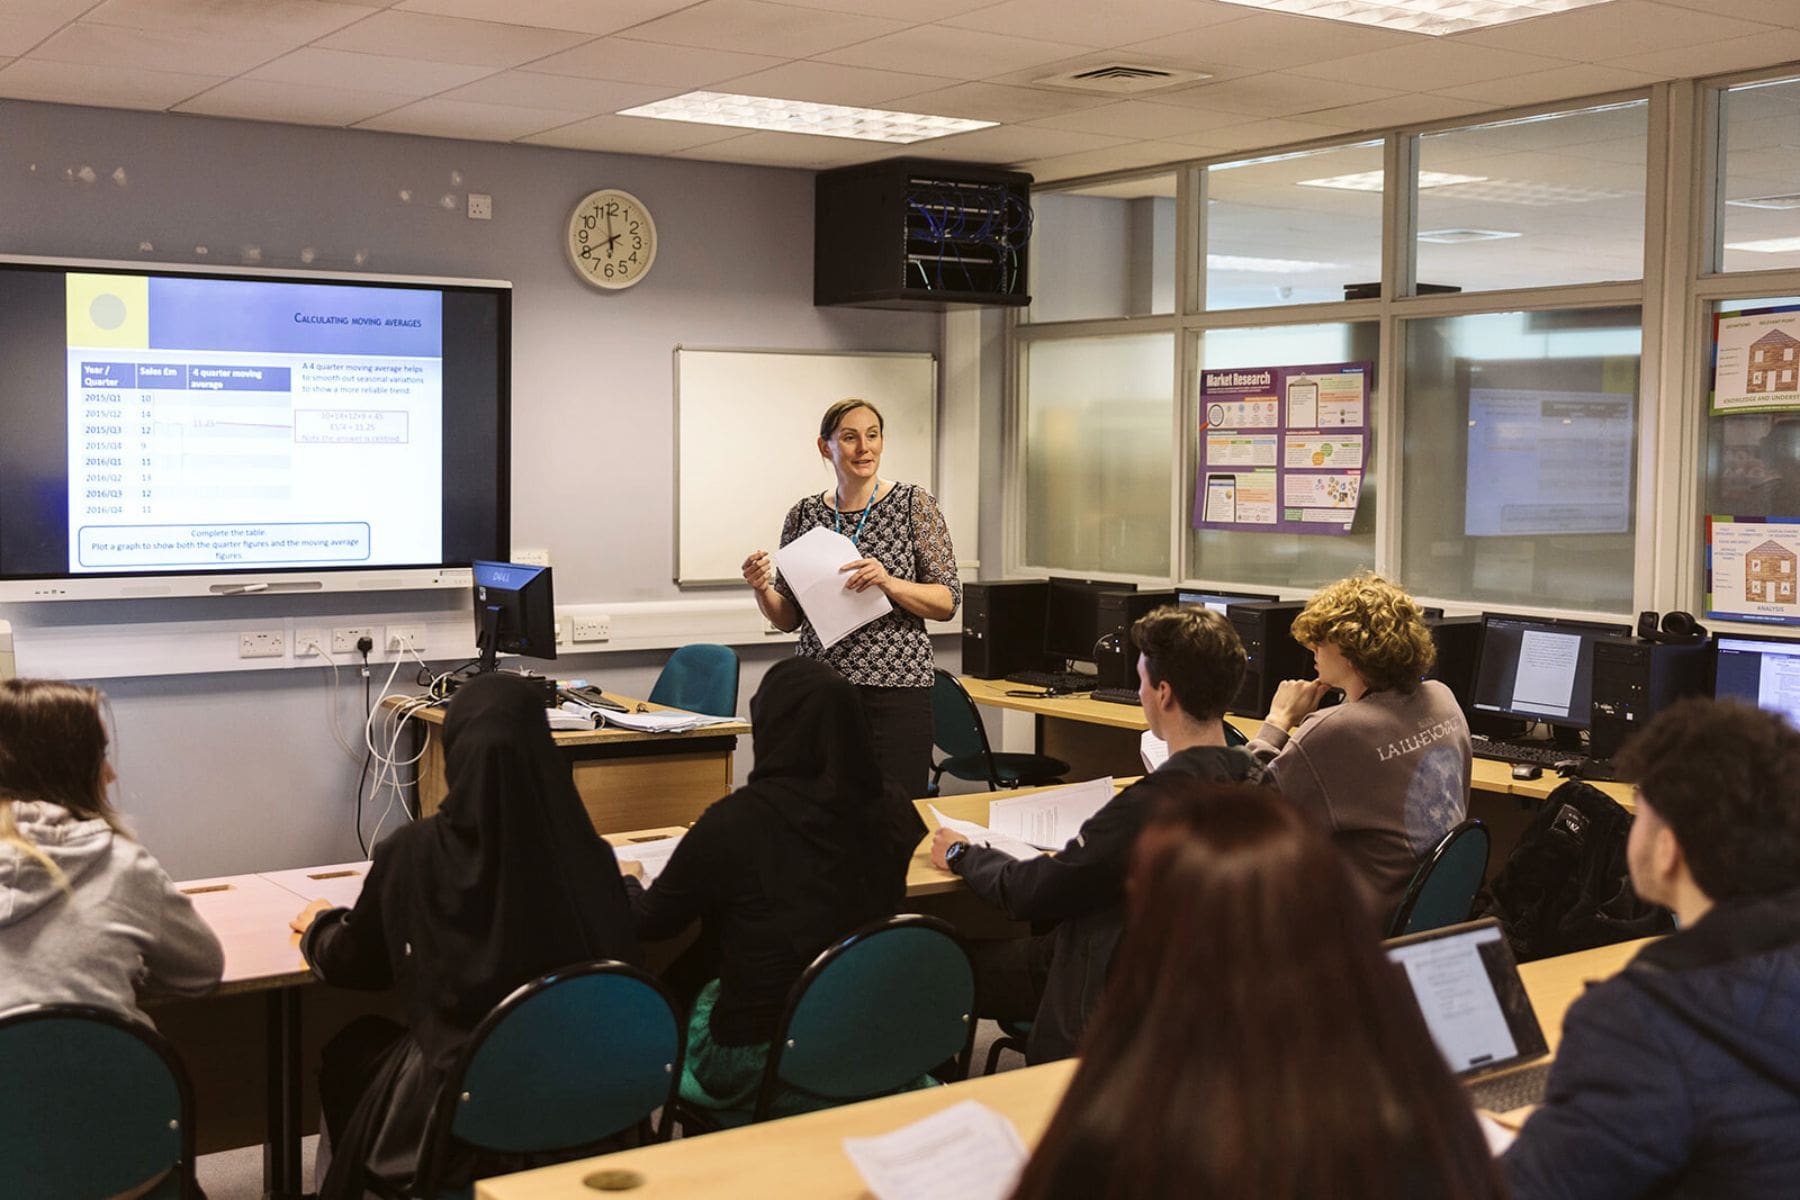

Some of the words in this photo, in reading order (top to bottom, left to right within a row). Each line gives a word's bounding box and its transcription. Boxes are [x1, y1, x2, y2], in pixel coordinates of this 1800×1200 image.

[593, 206, 604, 219] 11
[605, 202, 620, 217] 12
[623, 209, 629, 222] 1
[582, 215, 596, 230] 10
[629, 221, 640, 235] 2
[578, 230, 588, 244] 9
[632, 236, 642, 250] 3
[581, 245, 592, 259] 8
[628, 251, 638, 264] 4
[592, 257, 601, 271] 7
[618, 260, 628, 274] 5
[604, 263, 614, 278] 6
[84, 365, 103, 375] Year
[139, 367, 162, 376] Sales
[163, 367, 178, 376] £m
[192, 369, 198, 377] 4
[200, 370, 231, 379] quarter
[232, 370, 263, 380] moving
[84, 378, 119, 388] Quarter
[191, 381, 223, 389] average
[1206, 373, 1233, 387] Market
[1233, 371, 1271, 386] Research
[85, 394, 122, 402] 2015/Q1
[85, 410, 122, 418] 2015/Q2
[85, 426, 122, 435] 2015/Q3
[85, 441, 122, 450] 2015/Q4
[85, 458, 122, 466] 2016/Q1
[85, 473, 122, 482] 2016/Q2
[85, 489, 122, 498] 2016/Q3
[85, 505, 122, 514] 2016/Q4
[191, 529, 229, 538] Complete
[231, 528, 244, 536] the
[91, 542, 108, 551] Plot
[117, 543, 140, 552] graph
[153, 542, 174, 550] show
[176, 541, 195, 550] both
[197, 541, 210, 549] the
[212, 541, 241, 550] quarter
[243, 540, 269, 549] figures
[271, 540, 285, 548] and
[287, 539, 300, 547] the
[301, 539, 328, 547] moving
[330, 539, 359, 547] average
